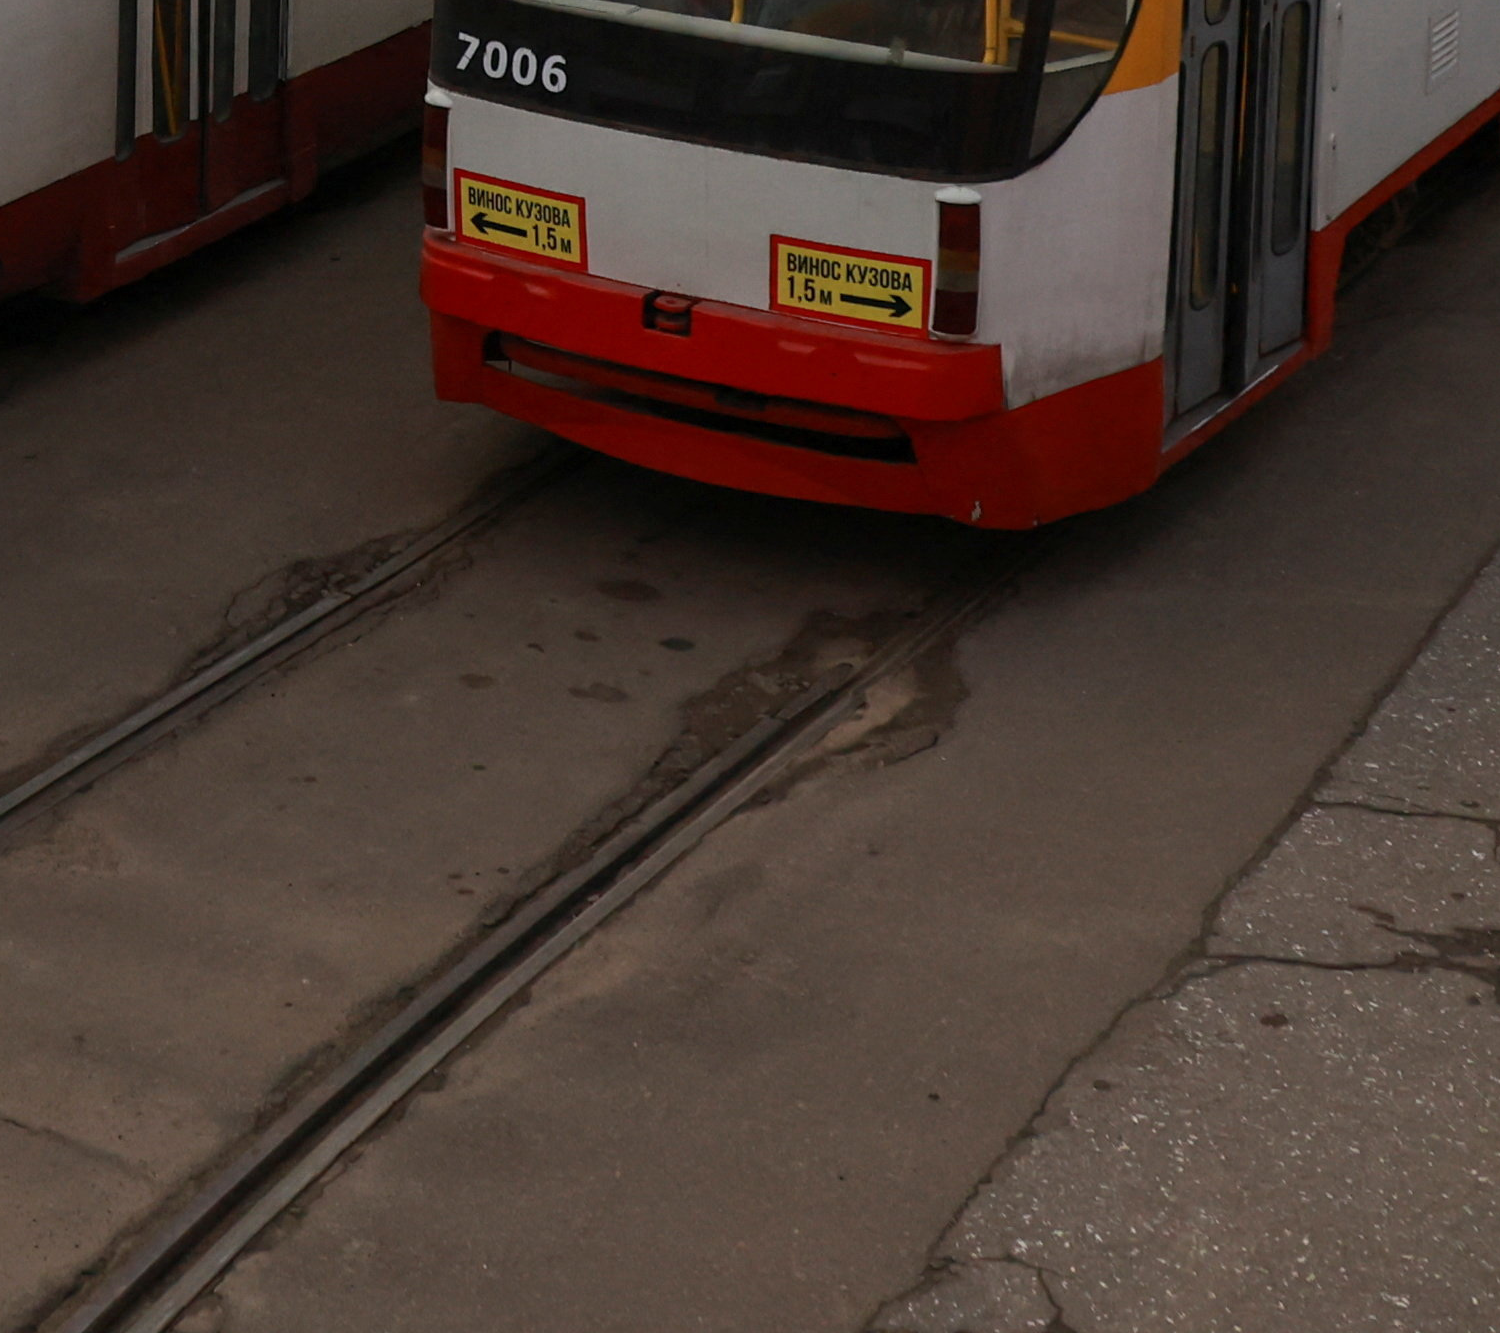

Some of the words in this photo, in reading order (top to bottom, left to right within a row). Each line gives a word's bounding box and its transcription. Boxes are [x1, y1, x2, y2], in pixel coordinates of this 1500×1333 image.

[456, 32, 567, 93] 7006
[468, 186, 512, 215] ВИНОС
[515, 197, 571, 228] КУЗОВА
[532, 224, 557, 251] 1,5
[787, 252, 841, 281] ВИНОС
[845, 263, 913, 293] КУЗОВА
[787, 275, 815, 303] 1,5
